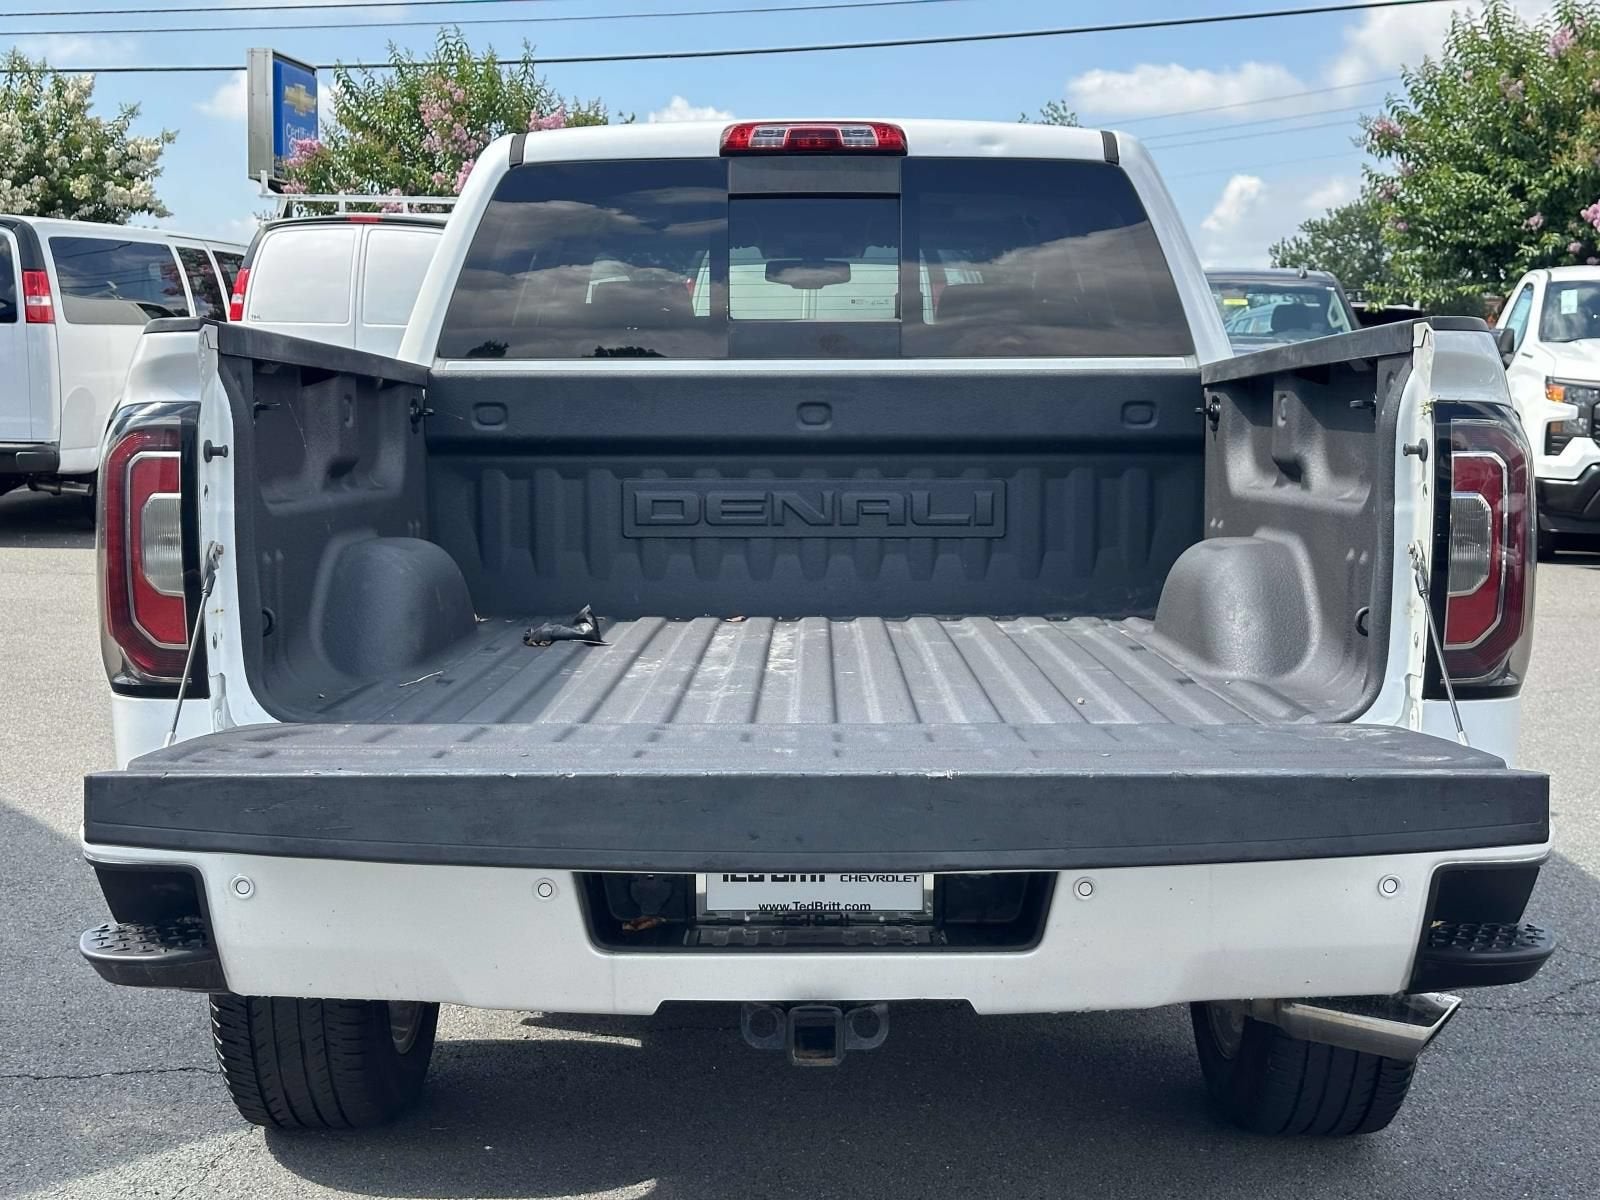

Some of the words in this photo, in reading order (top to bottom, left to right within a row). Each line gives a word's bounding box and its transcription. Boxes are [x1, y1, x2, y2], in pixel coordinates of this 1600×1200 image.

[635, 490, 994, 526] DENALI
[840, 874, 920, 883] CHEVROLET
[758, 901, 871, 911] www.TedBritt.com
